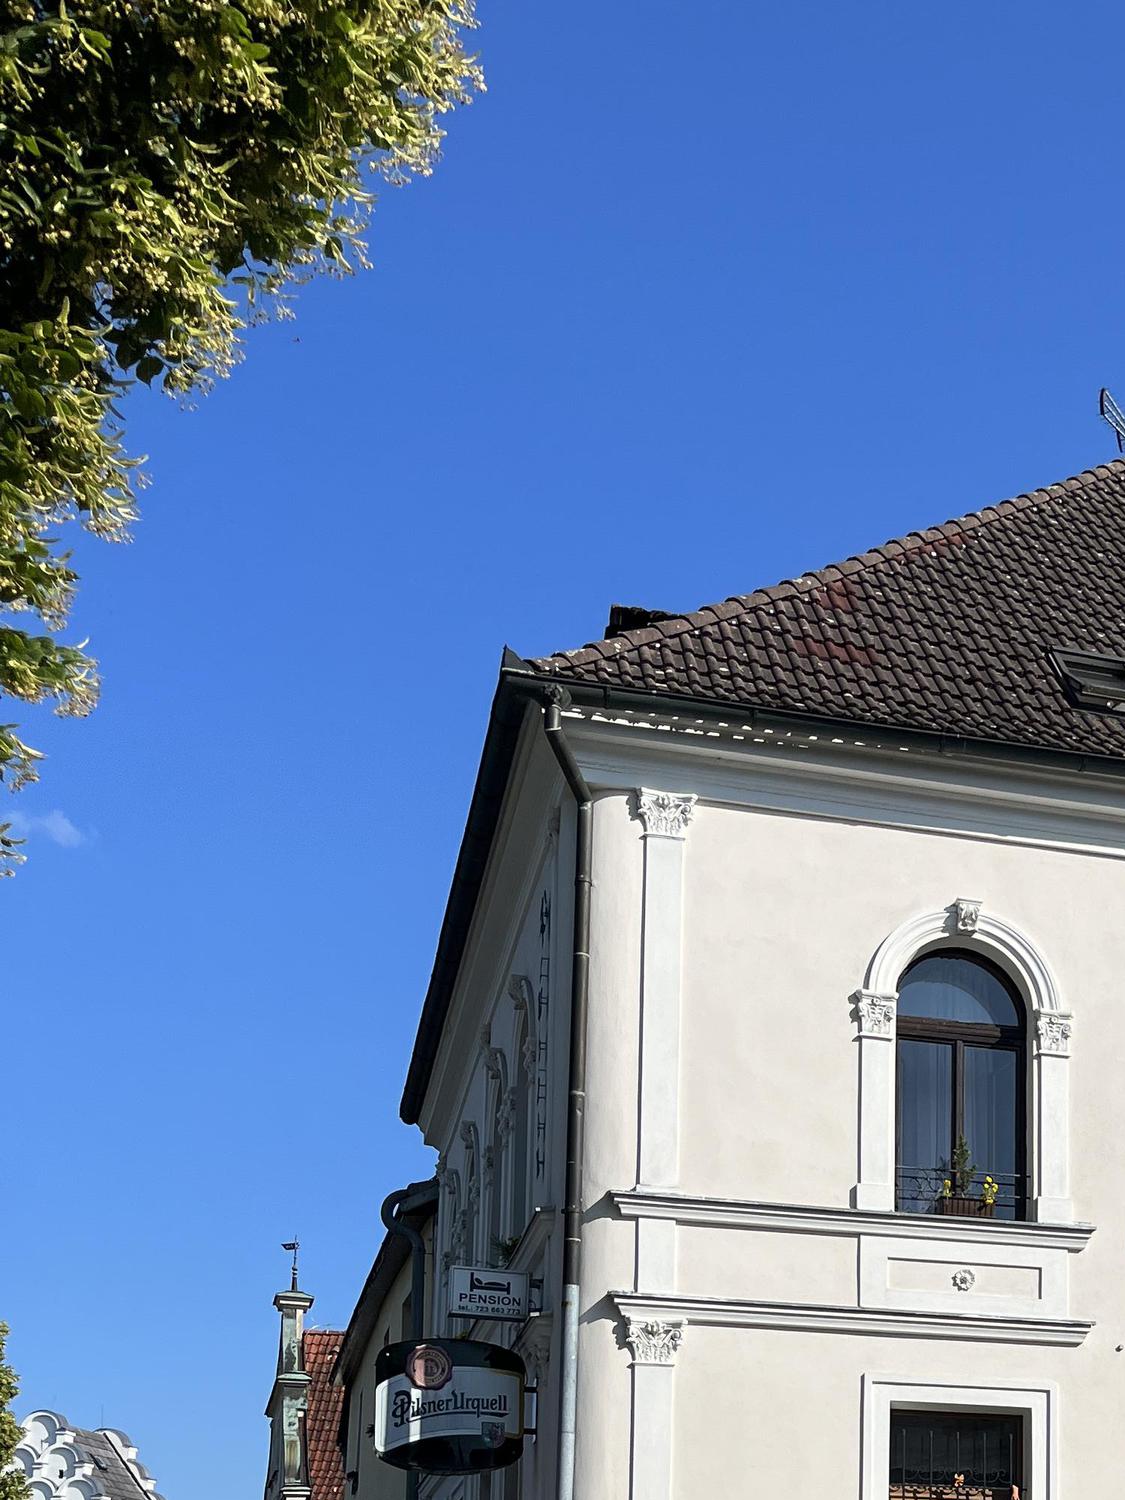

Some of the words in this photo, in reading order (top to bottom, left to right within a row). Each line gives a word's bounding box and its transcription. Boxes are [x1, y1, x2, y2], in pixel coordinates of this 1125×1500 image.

[459, 1293, 521, 1307] PENSION
[391, 1390, 452, 1427] Pilsner
[451, 1389, 508, 1418] Urquell
